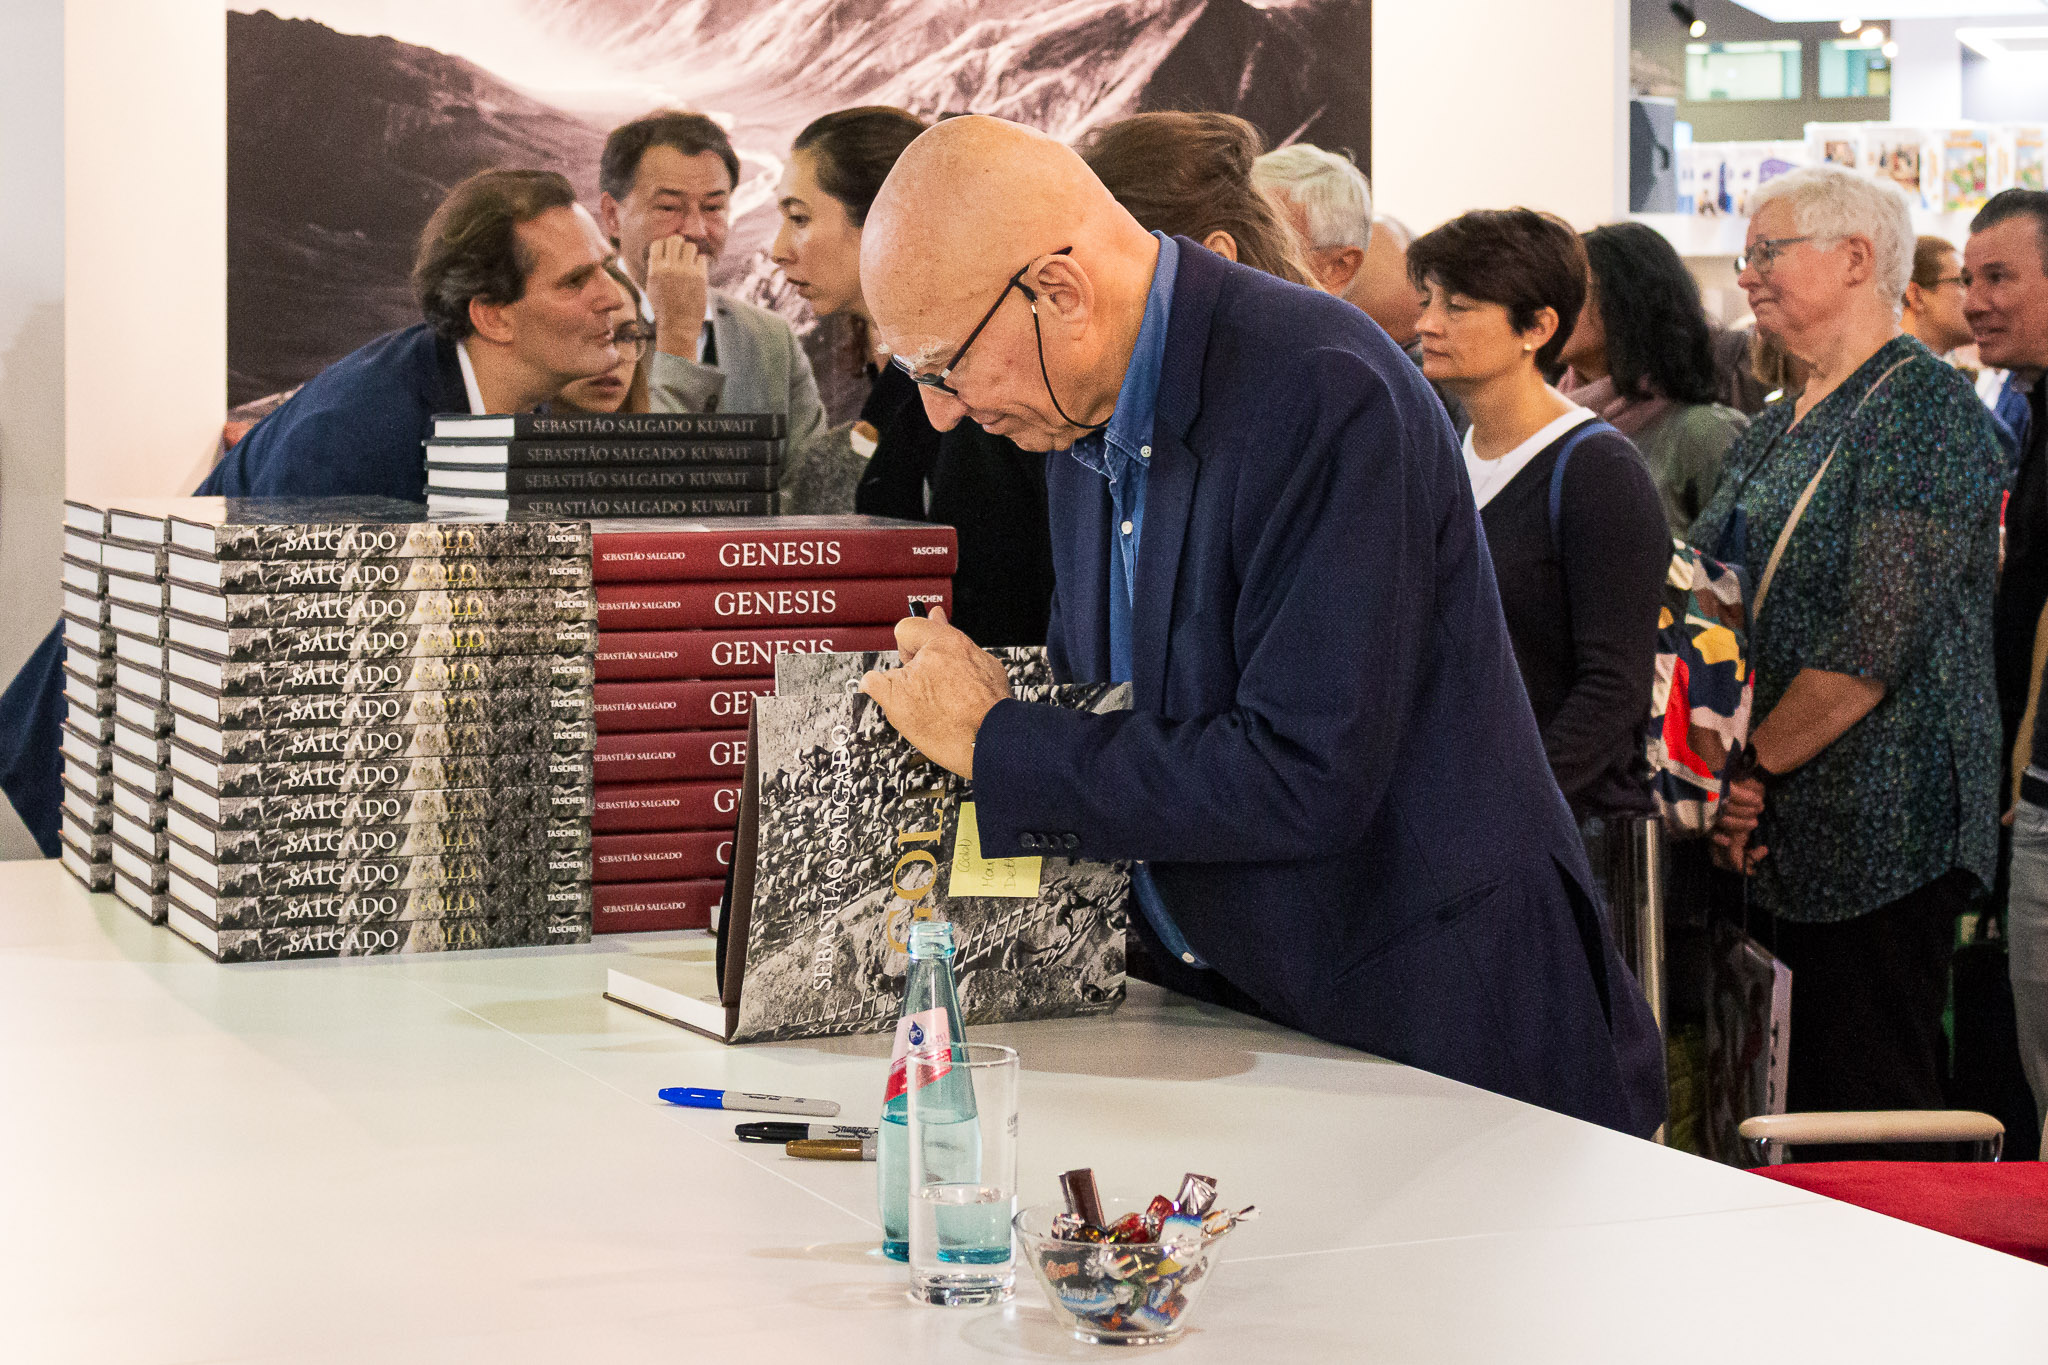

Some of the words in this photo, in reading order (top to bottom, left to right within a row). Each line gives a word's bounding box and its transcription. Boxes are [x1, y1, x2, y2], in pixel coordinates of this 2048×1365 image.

[533, 418, 614, 433] SEBASTIÃO
[618, 419, 692, 433] SALGADO
[697, 419, 757, 433] KUWAIT
[527, 446, 609, 462] SEBASTIÃO
[613, 447, 686, 461] SALGADO
[691, 447, 750, 460] KUWAIT
[525, 472, 607, 488] SEBASTIÃO
[610, 473, 684, 487] SALGADO
[689, 472, 749, 486] KUWAIT
[528, 500, 610, 516] SEBASTIÃO
[613, 501, 687, 515] SALGADO
[691, 500, 752, 514] KUWAIT
[286, 532, 396, 551] SALGADO
[409, 531, 474, 549] GOLD
[602, 552, 645, 561] SEBASTIÃO
[646, 552, 686, 560] SALGADO
[718, 541, 841, 567] GENESIS
[911, 546, 948, 555] TASCHEN
[290, 565, 399, 585] SALGADO
[413, 564, 477, 582] GOLD
[549, 567, 583, 575] TASCHEN
[555, 600, 589, 608] TASCHEN
[598, 601, 641, 610] SEBASTIÃO
[641, 601, 681, 609] SALGADO
[714, 589, 836, 616] GENESIS
[907, 594, 943, 603] TASCHEN
[297, 599, 405, 620] SALGADO
[299, 631, 407, 653] SALGADO
[595, 651, 637, 660] SEBASTIÃO
[638, 651, 678, 660] SALGADO
[292, 665, 401, 686] SALGADO
[551, 666, 585, 674] TASCHEN
[290, 699, 400, 720] SALGADO
[550, 699, 584, 707] TASCHEN
[594, 702, 636, 712] SEBASTIÃO
[637, 701, 677, 710] SALGADO
[292, 732, 402, 753] SALGADO
[553, 732, 587, 740] TASCHEN
[593, 751, 635, 762] SEBASTIÃO
[636, 751, 676, 761] SALGADO
[289, 766, 398, 787] SALGADO
[829, 724, 852, 853] SALGADO
[551, 797, 585, 805] TASCHEN
[597, 799, 639, 810] SEBASTIÃO
[640, 799, 680, 808] SALGADO
[291, 799, 400, 820] SALGADO
[287, 831, 396, 853] SALGADO
[549, 861, 583, 869] TASCHEN
[599, 852, 642, 863] SEBASTIÃO
[643, 852, 682, 861] SALGADO
[289, 864, 398, 886] SALGADO
[287, 897, 397, 919] SALGADO
[602, 903, 645, 913] SEBASTIÃO
[646, 902, 686, 911] SALGADO
[814, 858, 846, 991] SEBASTIÃO
[289, 929, 398, 952] SALGADO
